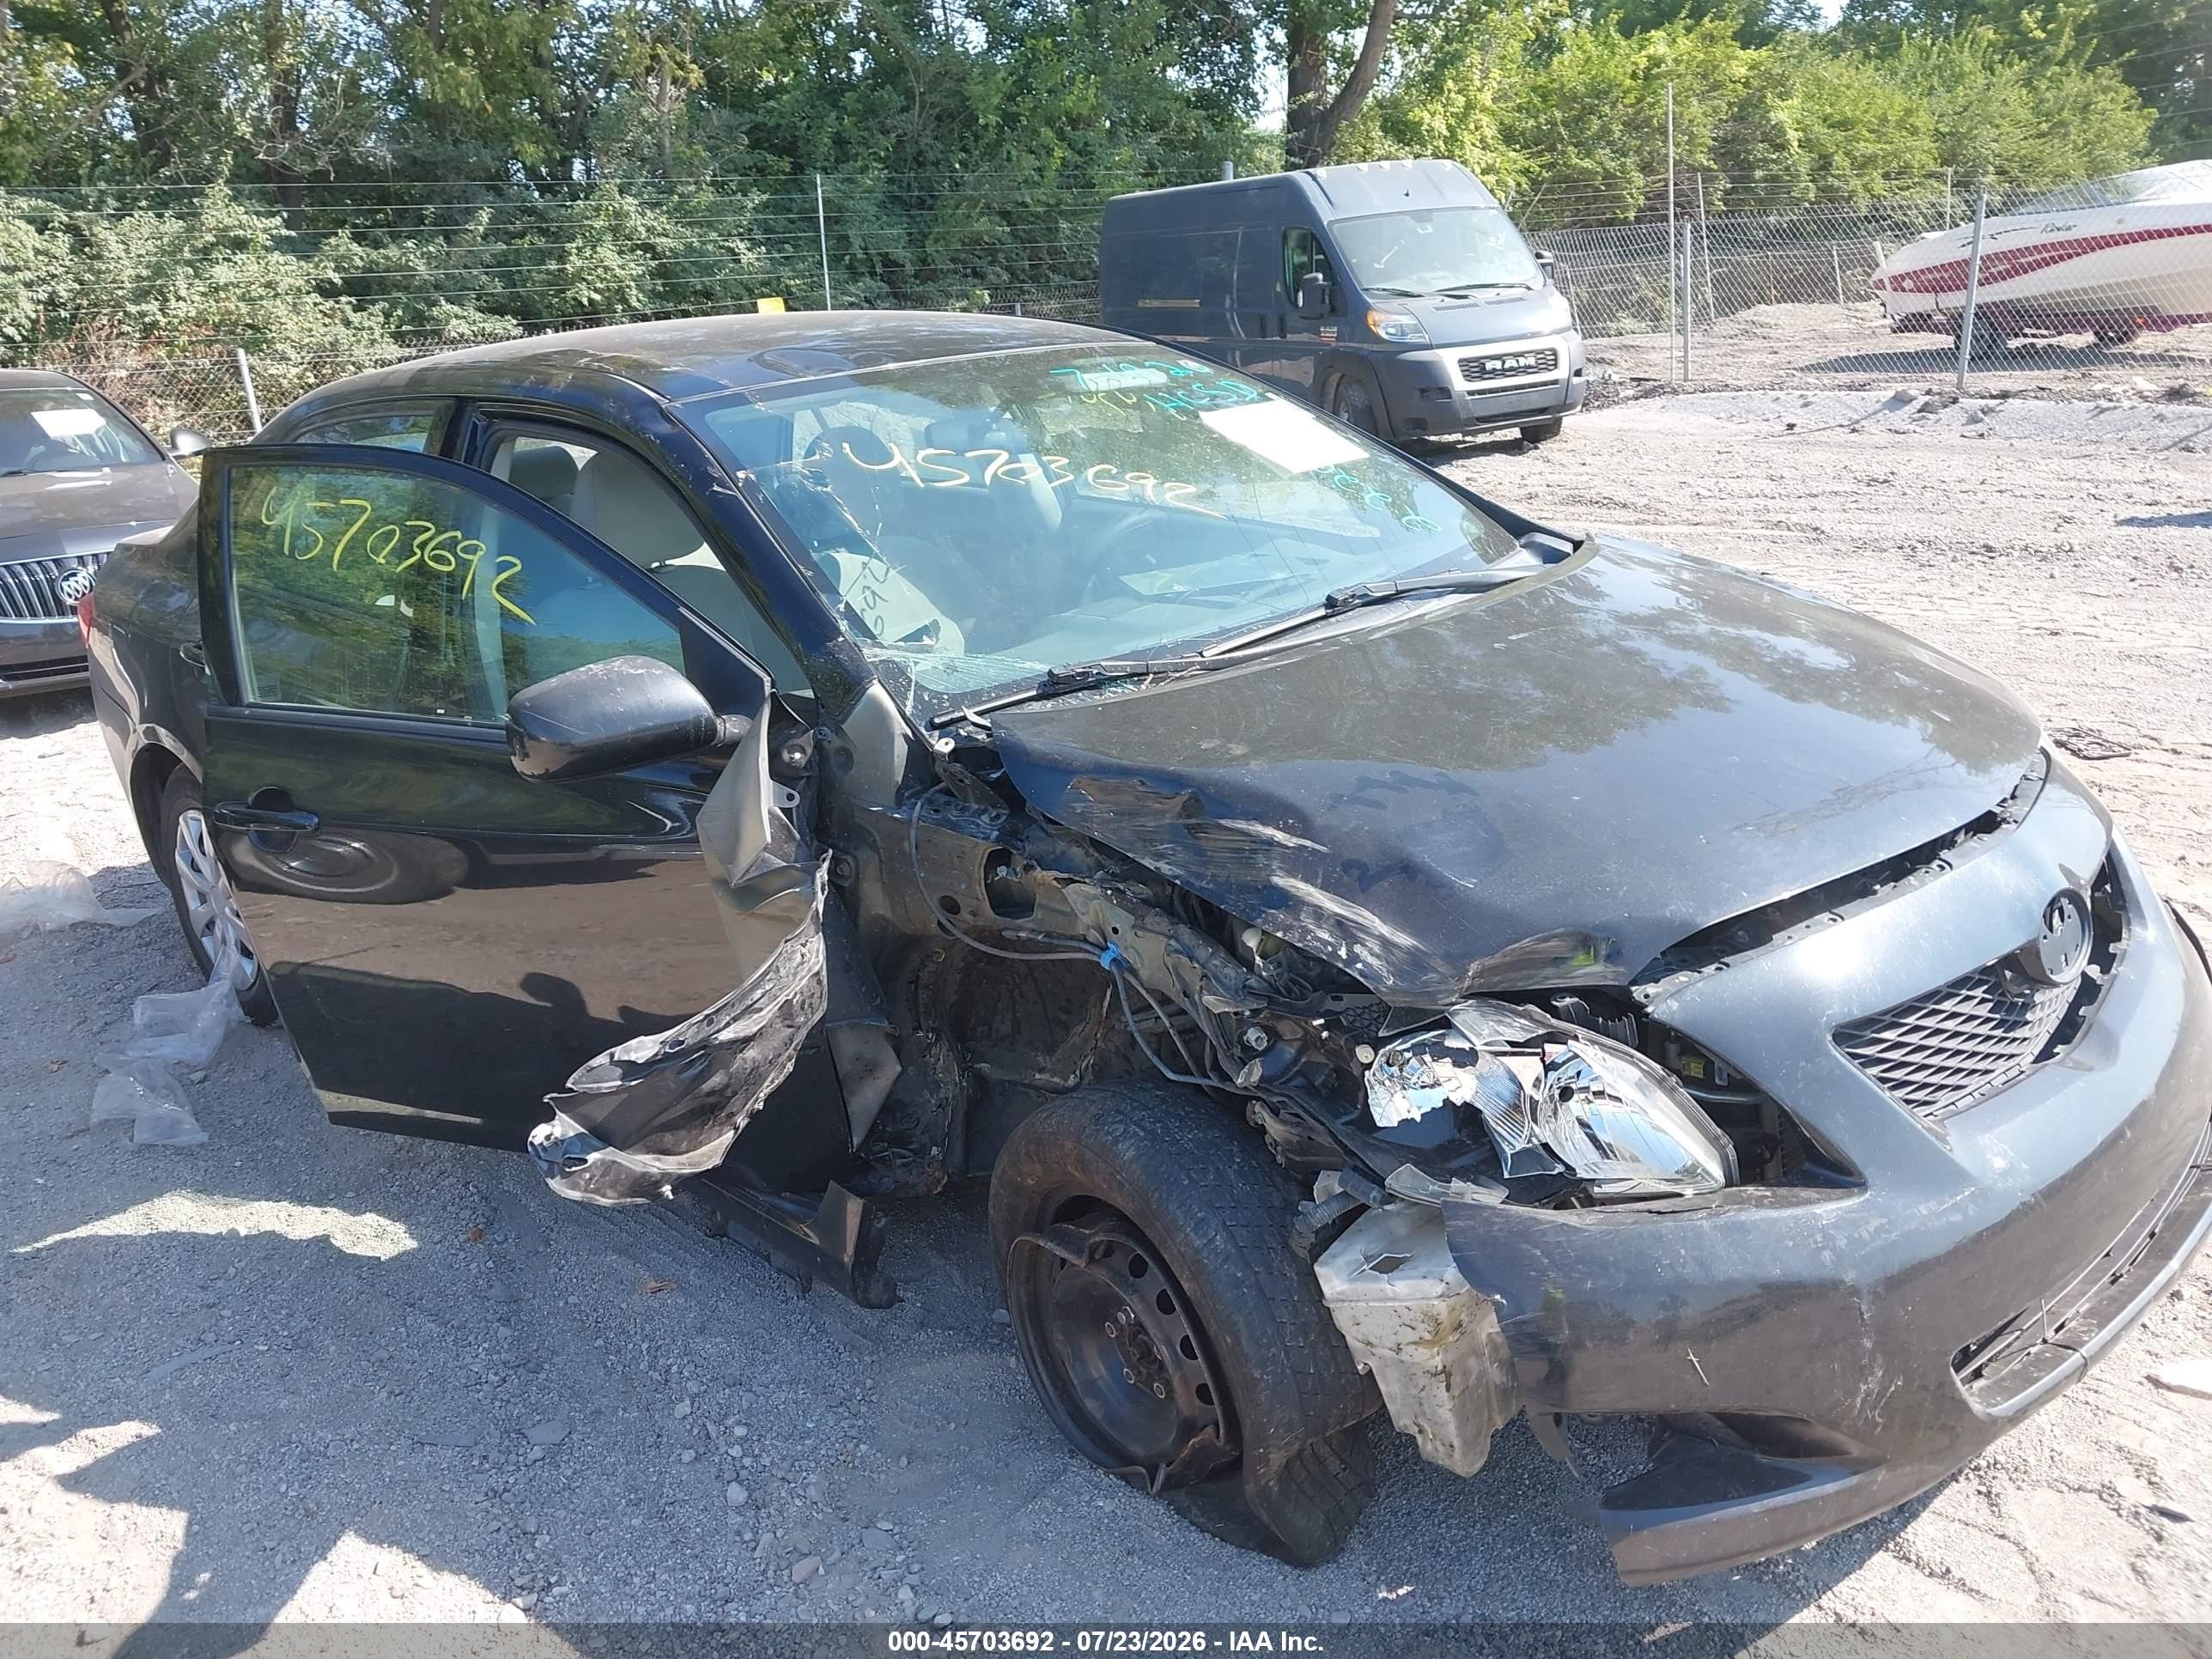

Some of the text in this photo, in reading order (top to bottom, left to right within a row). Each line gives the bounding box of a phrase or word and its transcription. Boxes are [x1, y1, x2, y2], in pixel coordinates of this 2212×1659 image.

[1485, 356, 1536, 371] RAM
[841, 441, 1229, 520] 45703692
[261, 486, 537, 626] 45703692
